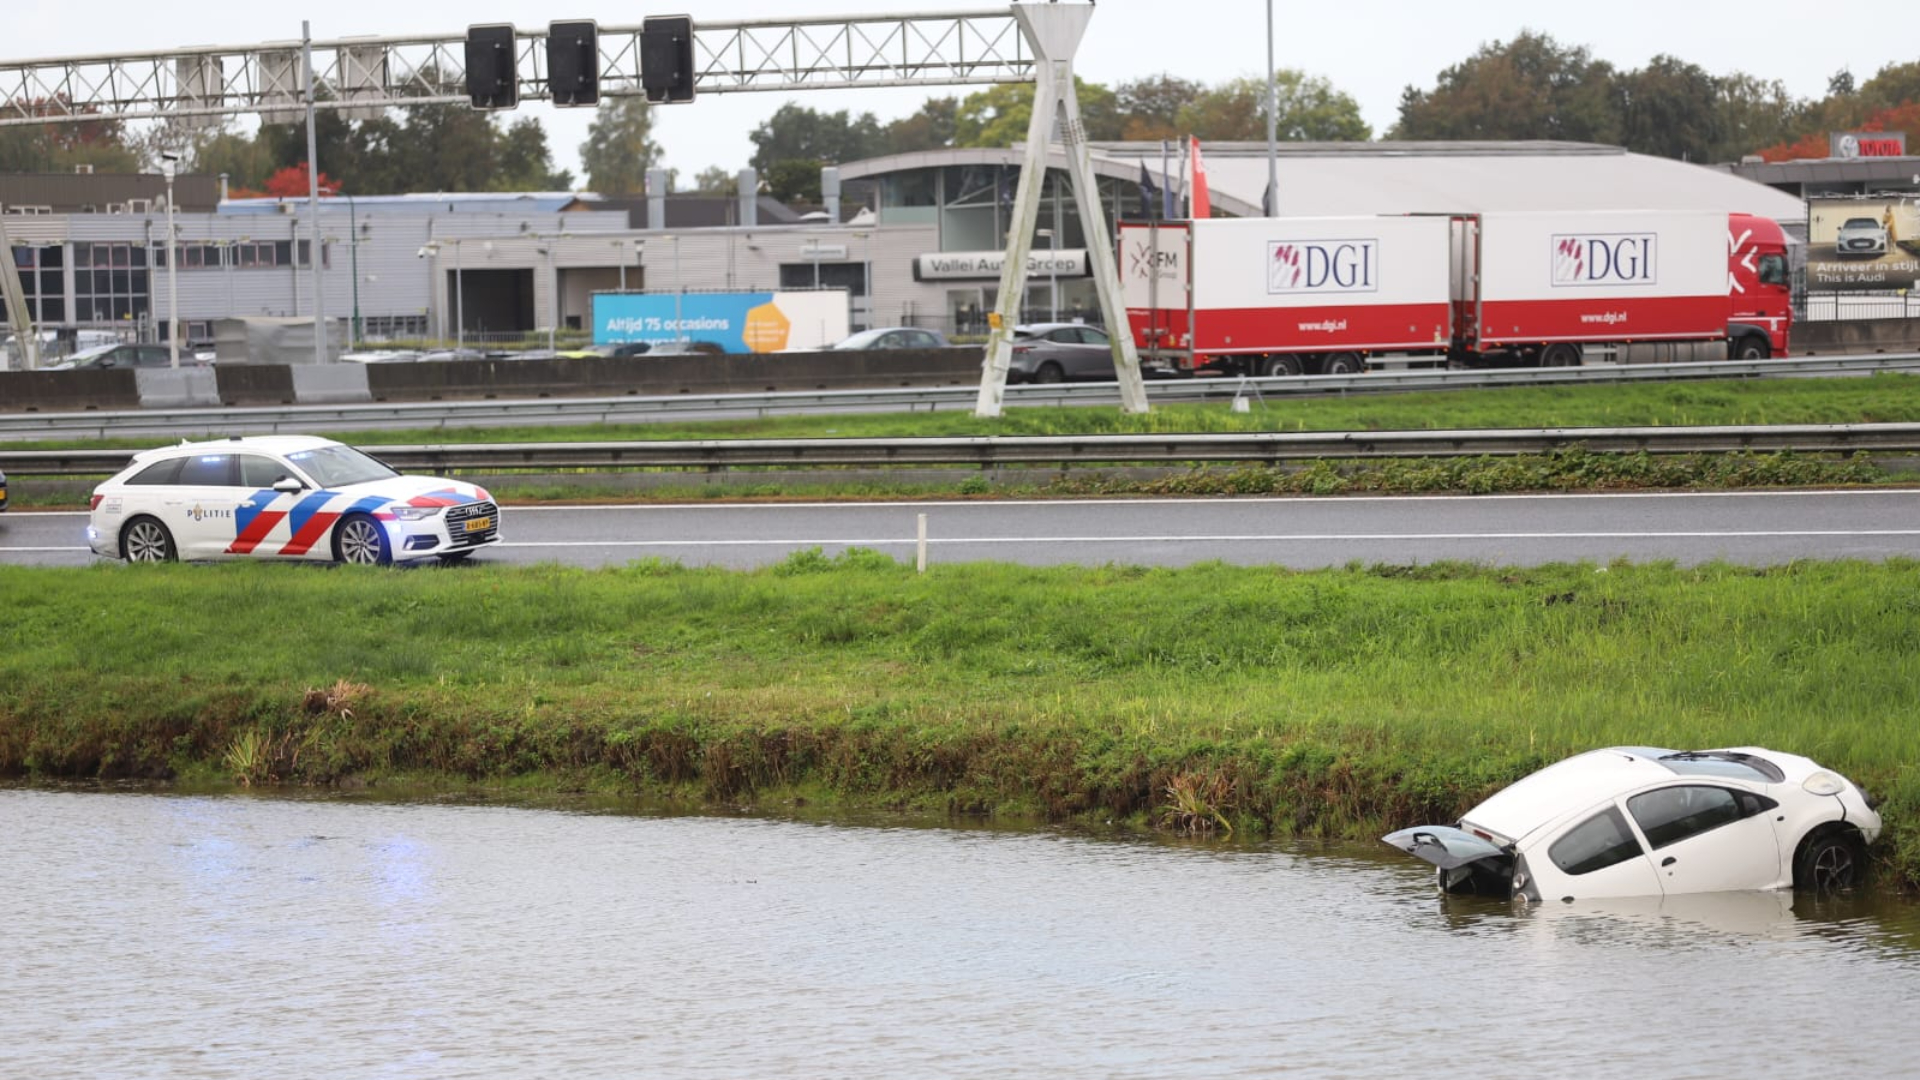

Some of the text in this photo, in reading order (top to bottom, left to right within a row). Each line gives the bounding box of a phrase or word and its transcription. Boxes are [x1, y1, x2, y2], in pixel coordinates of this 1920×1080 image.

[1858, 139, 1902, 157] TOYOTA
[931, 257, 1076, 272] Vallei Aut Groep
[1305, 244, 1373, 288] DGI
[1586, 238, 1651, 281] DGI
[1816, 260, 1919, 273] Arriveer in stijl
[1817, 272, 1886, 283] This is Audi
[606, 316, 730, 334] Altijd 75 occasions
[1580, 311, 1628, 325] www.dgi.nl
[1298, 319, 1347, 333] www.dgi.nl
[186, 508, 232, 521] POLITIE
